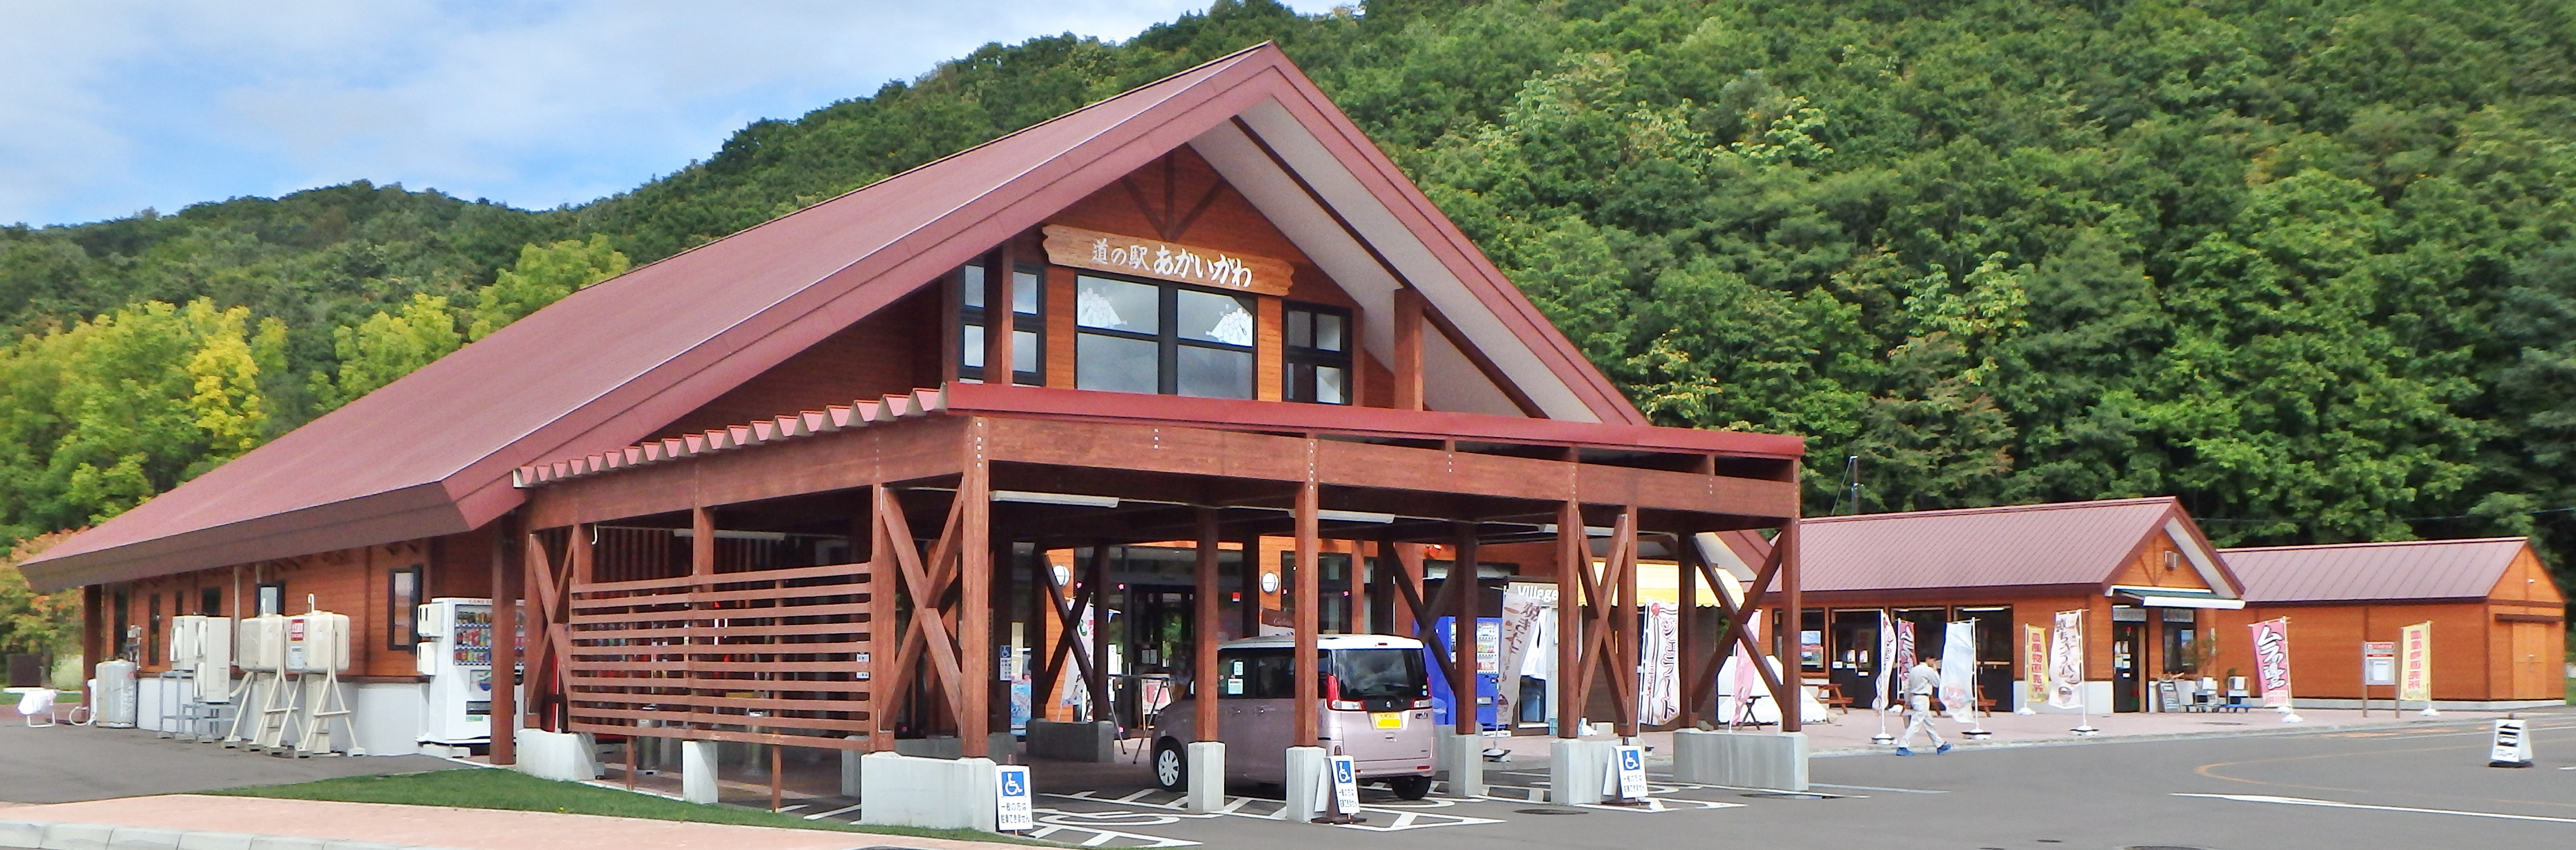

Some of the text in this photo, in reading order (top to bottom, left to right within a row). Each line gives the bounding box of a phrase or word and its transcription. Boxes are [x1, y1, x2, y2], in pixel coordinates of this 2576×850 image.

[1518, 585, 1559, 603] Village
[1001, 814, 1030, 823] 駐車できません
